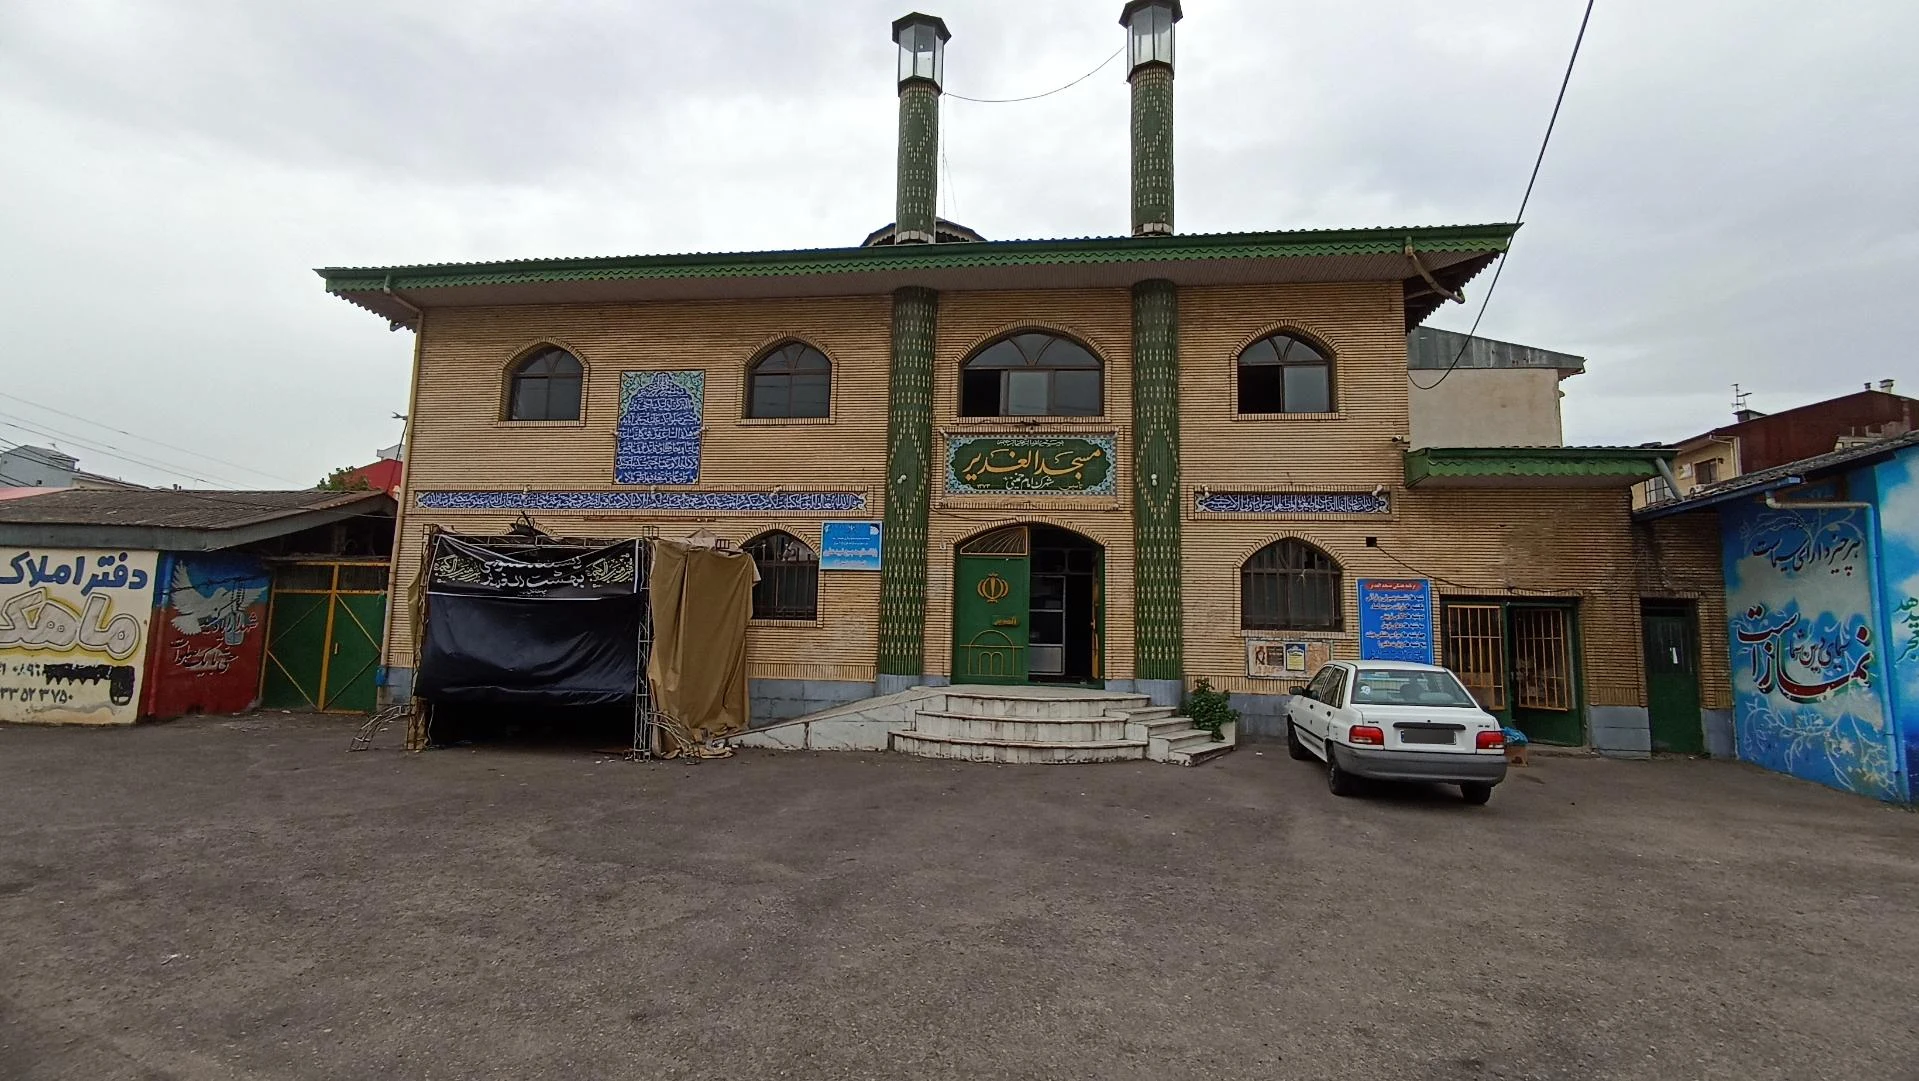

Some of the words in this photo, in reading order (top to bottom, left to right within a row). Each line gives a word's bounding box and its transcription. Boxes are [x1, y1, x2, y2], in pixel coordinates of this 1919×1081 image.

[962, 448, 1039, 482] الغدیر
[1004, 471, 1025, 491] خمینی
[1033, 449, 1103, 480] مسجد
[0, 551, 86, 588] املاک
[81, 552, 148, 596] دفتر
[1738, 603, 1799, 683] است
[1757, 625, 1873, 701] نماز
